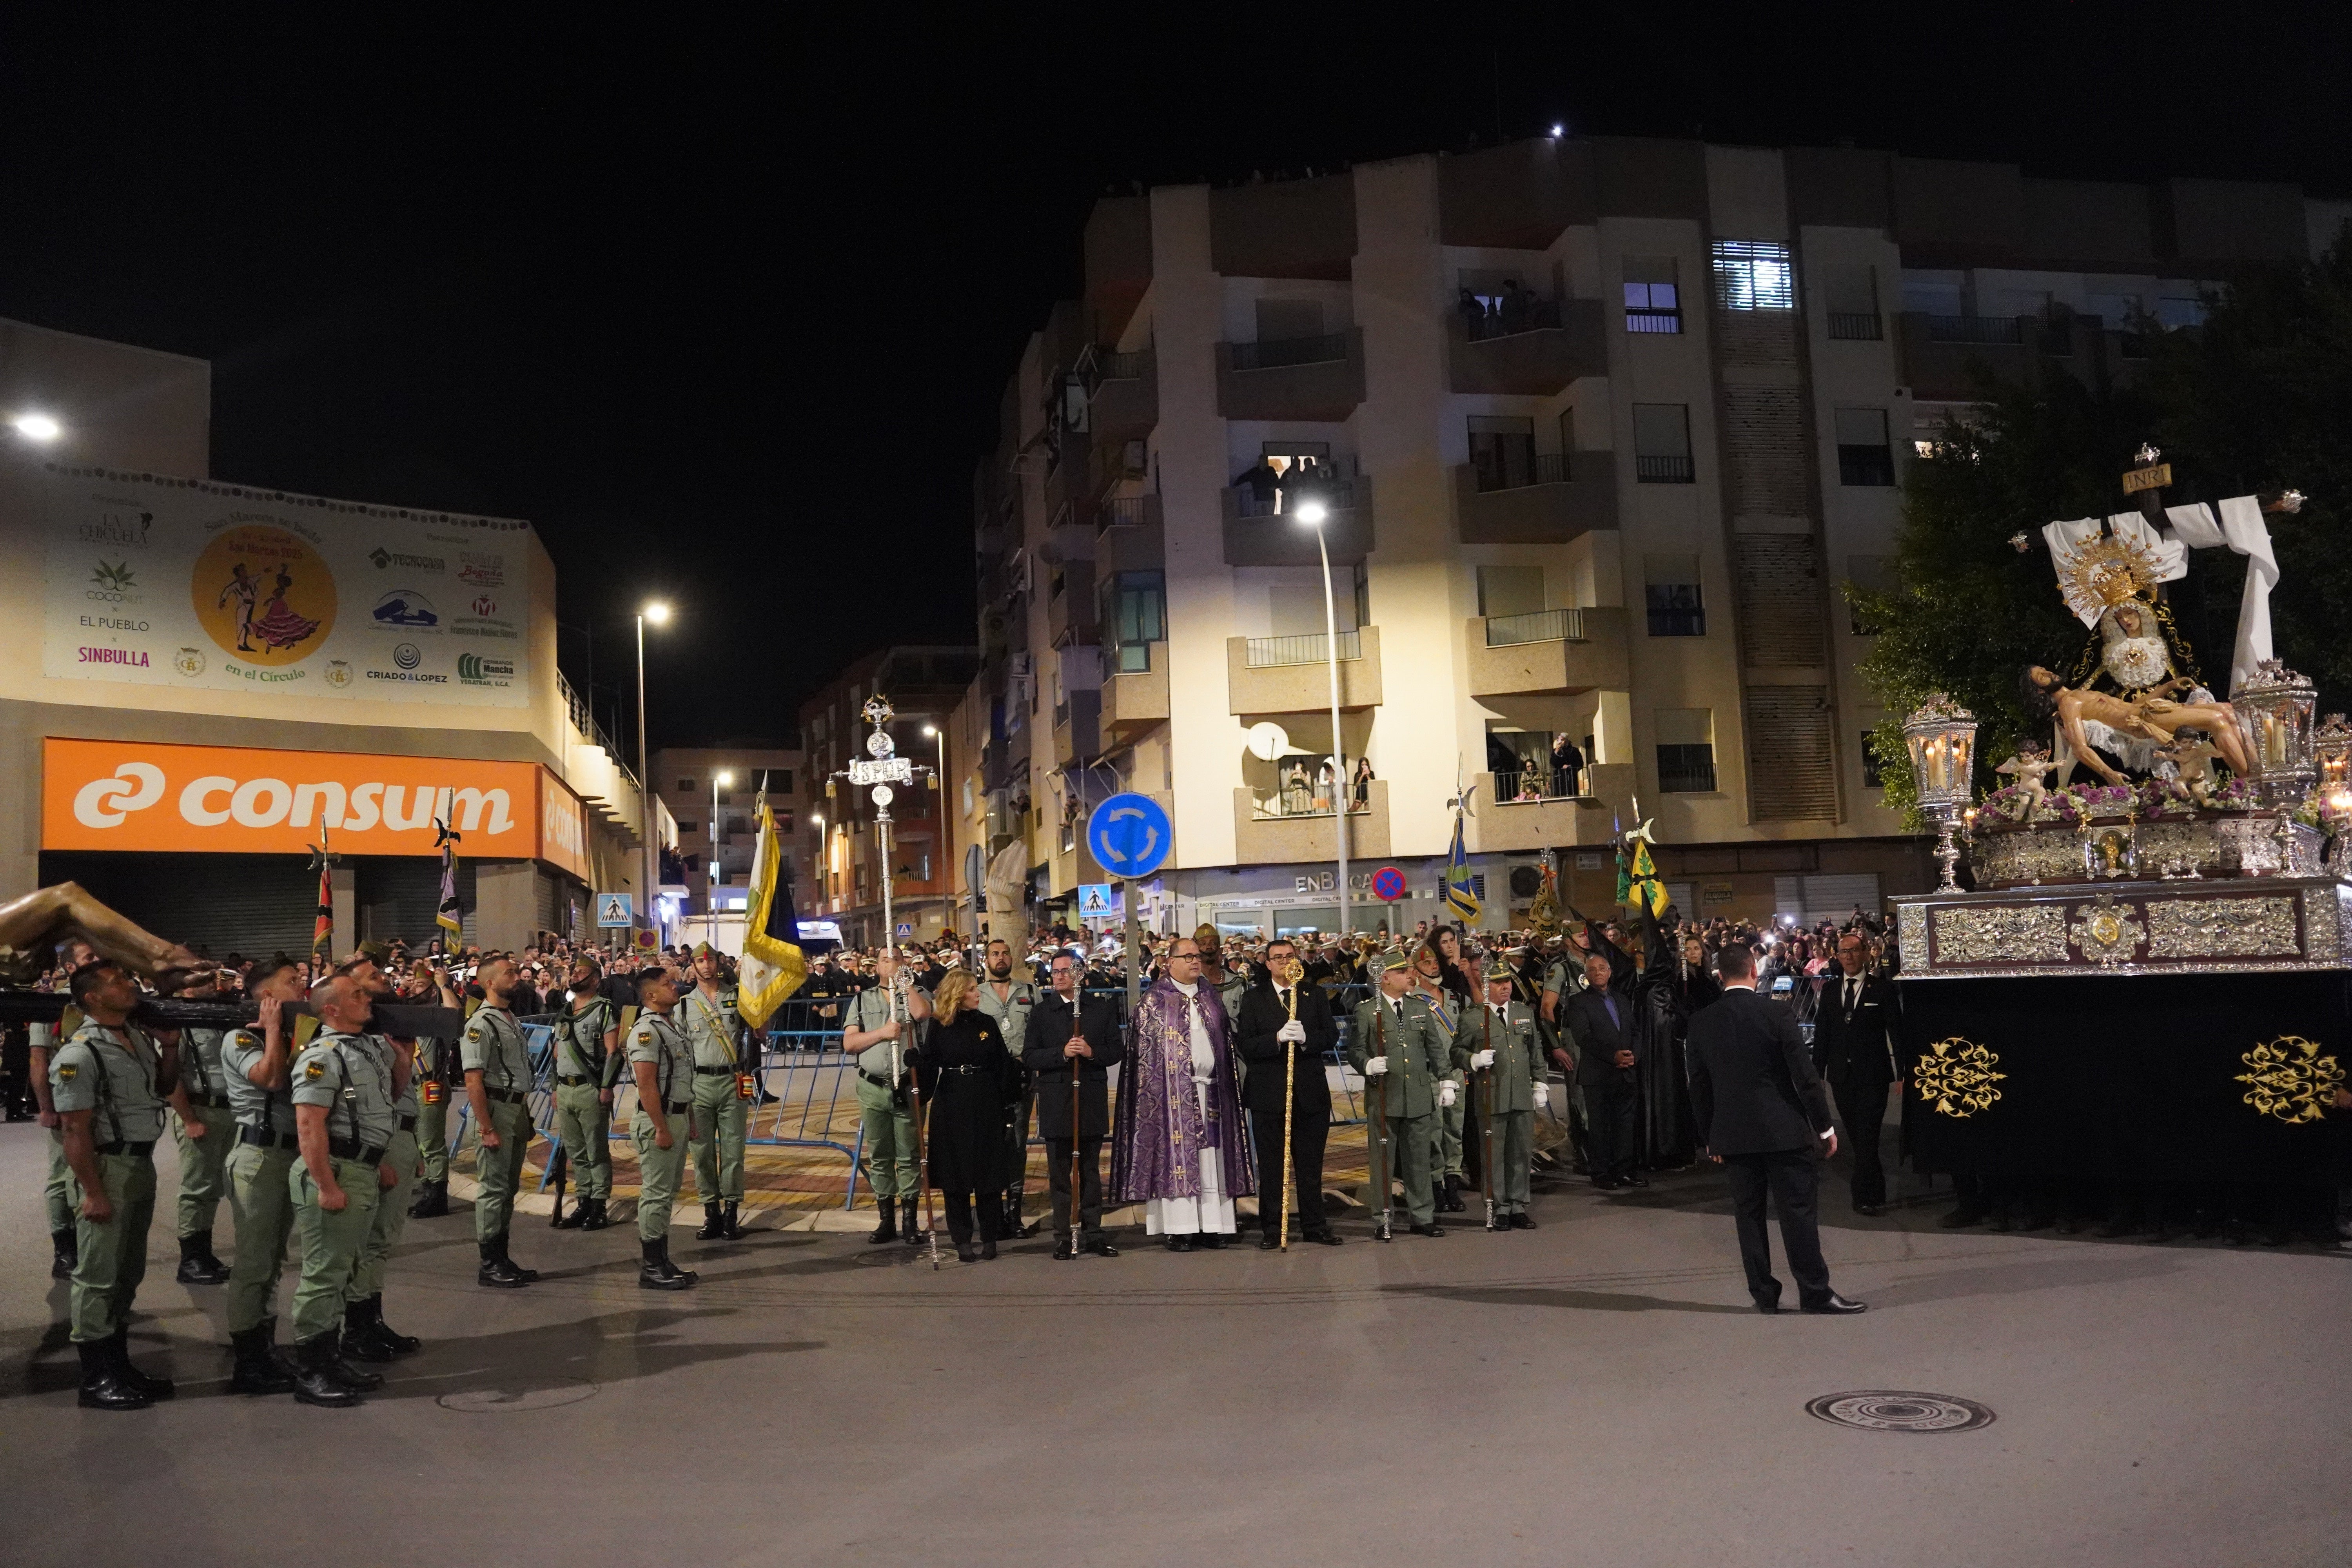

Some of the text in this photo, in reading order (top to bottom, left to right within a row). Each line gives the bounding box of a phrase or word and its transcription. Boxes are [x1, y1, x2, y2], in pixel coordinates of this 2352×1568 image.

[2127, 468, 2167, 490] INRI
[80, 615, 149, 632] EL PUEBLO
[78, 646, 150, 668] SINBULLA
[225, 664, 306, 682] en el Círculo
[484, 664, 514, 674] Mancha
[179, 776, 515, 835] consum
